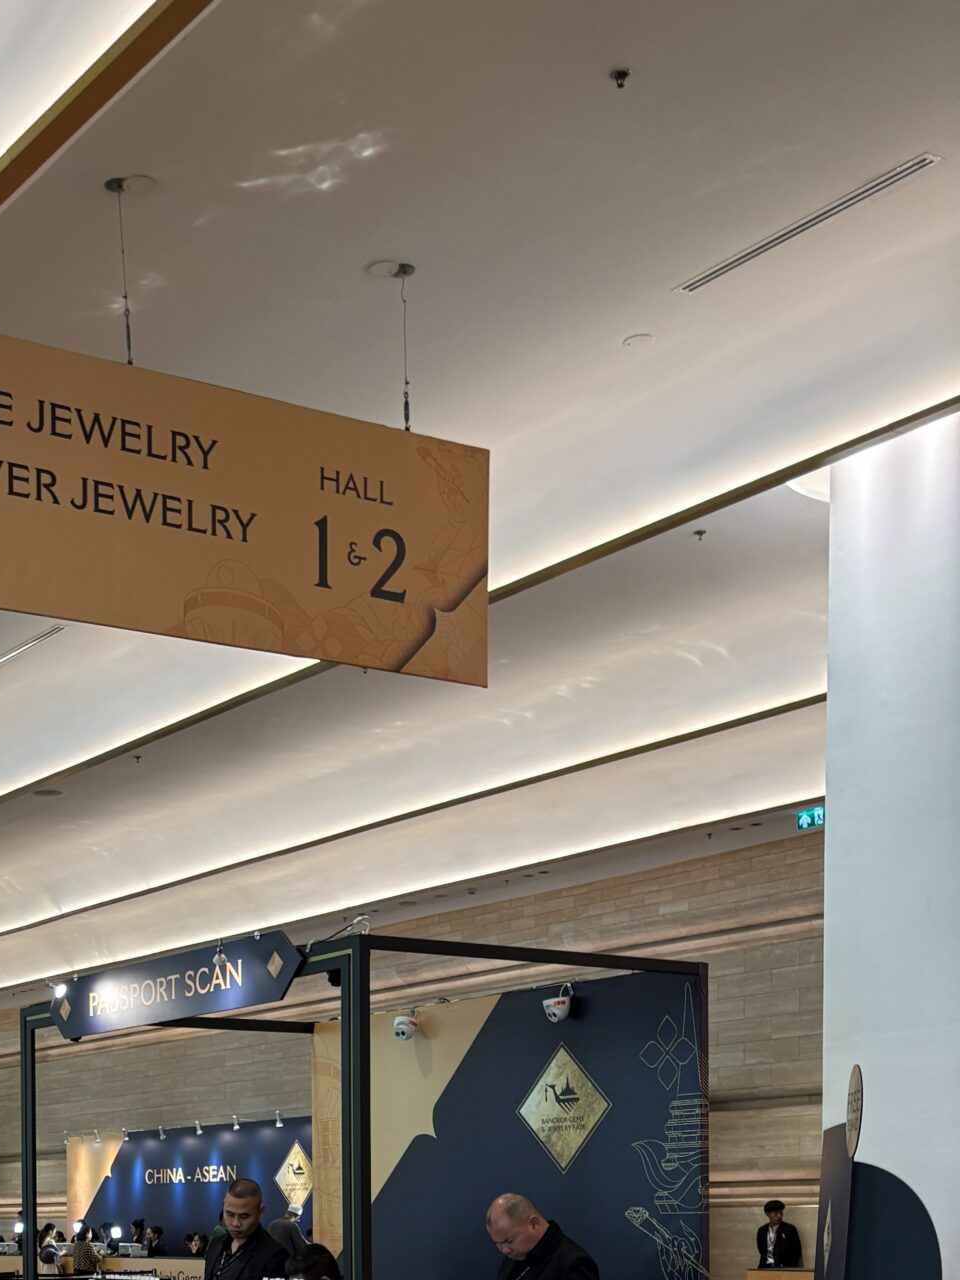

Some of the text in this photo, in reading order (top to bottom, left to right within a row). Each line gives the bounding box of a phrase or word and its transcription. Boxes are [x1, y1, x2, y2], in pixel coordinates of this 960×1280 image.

[26, 398, 219, 471] JEWELRY
[70, 476, 258, 544] JEWELRY
[319, 465, 394, 506] HALL
[313, 514, 408, 604] 1 & 2
[184, 959, 243, 998] SCAN
[145, 1167, 186, 1185] CHINA
[193, 1165, 238, 1183] ASEAN
